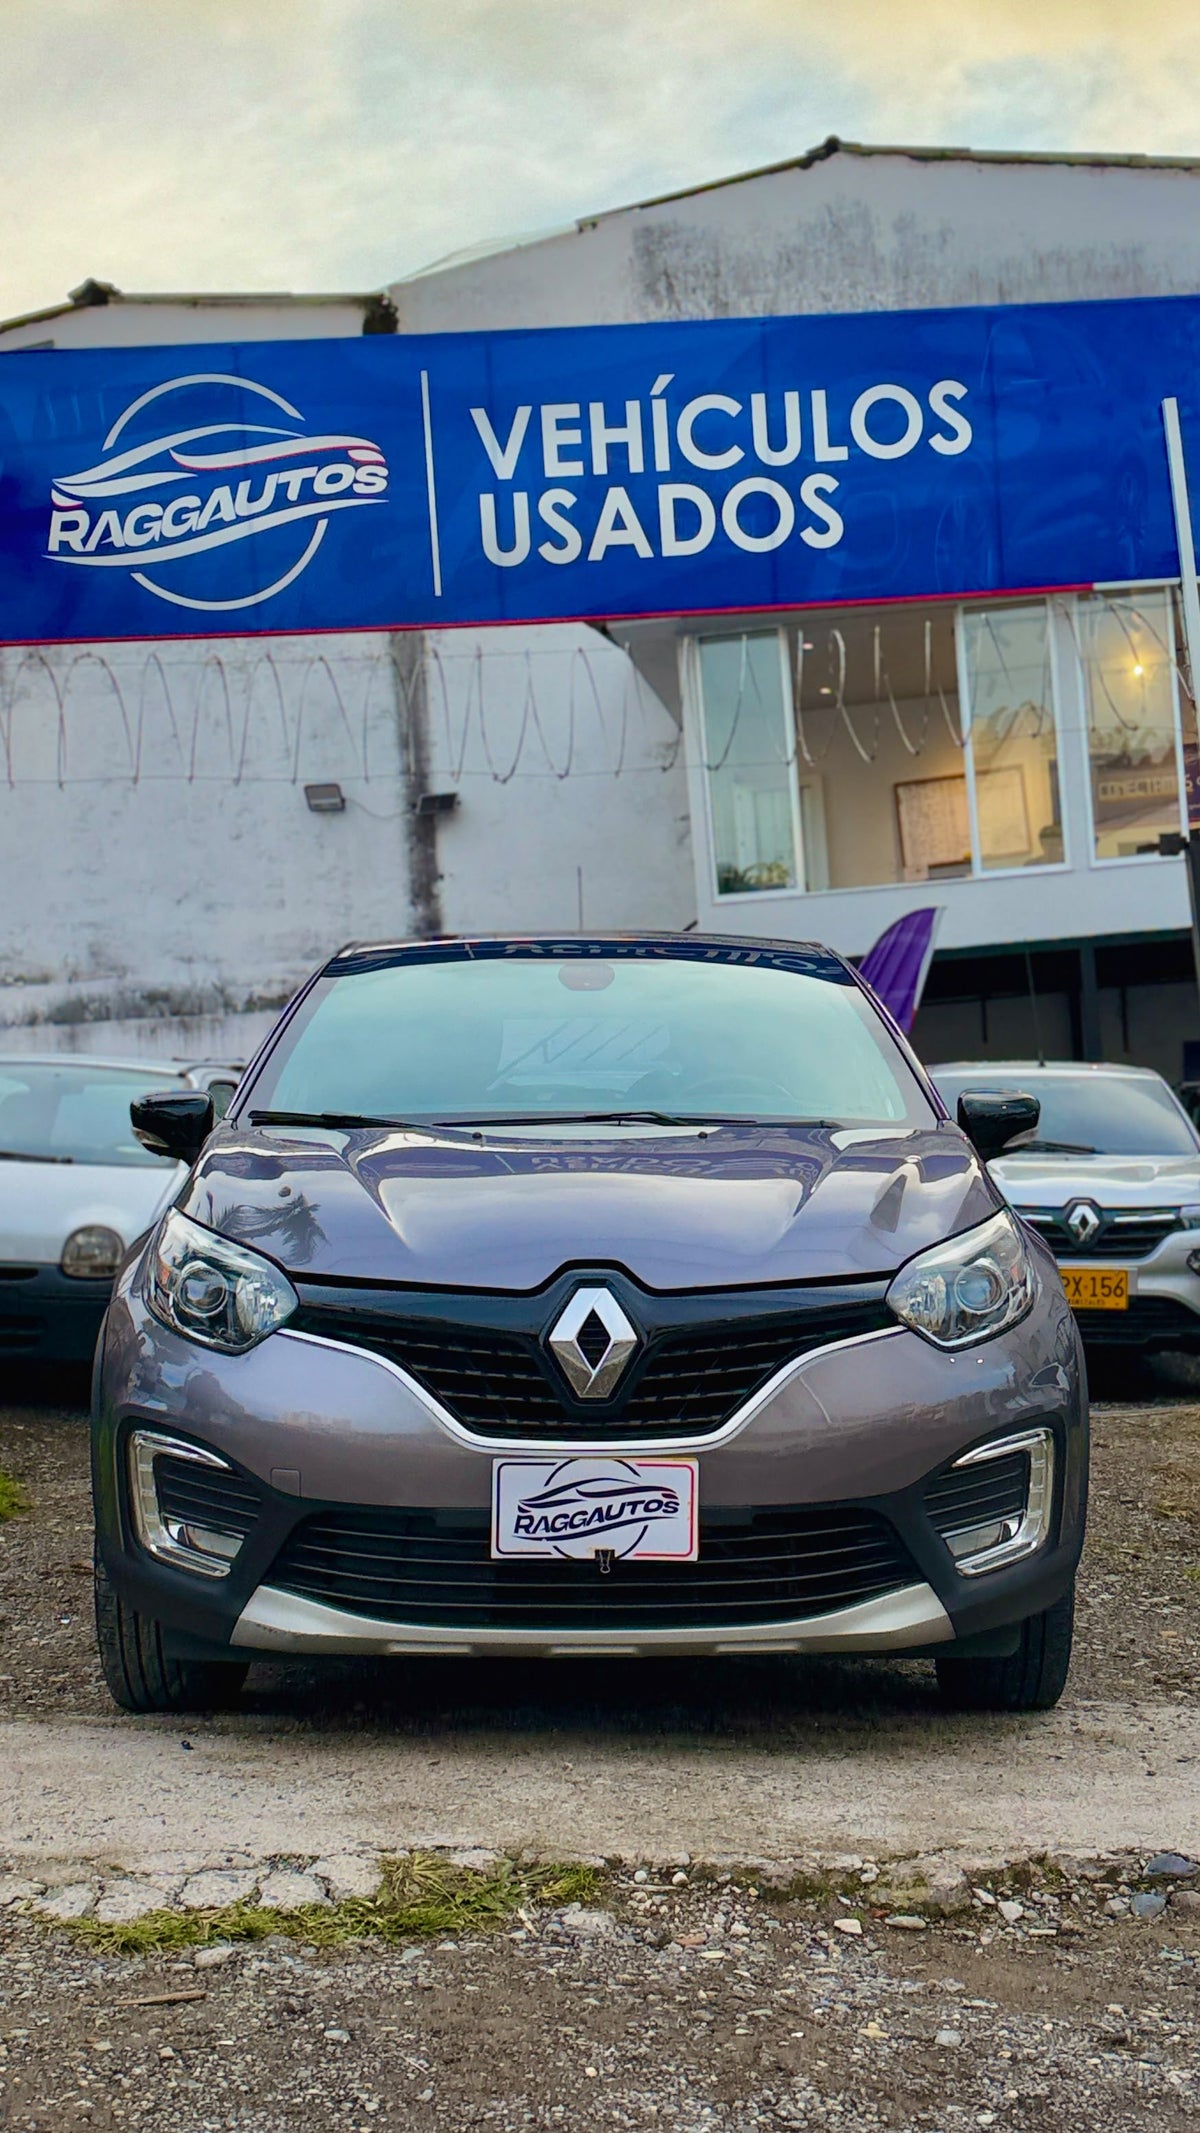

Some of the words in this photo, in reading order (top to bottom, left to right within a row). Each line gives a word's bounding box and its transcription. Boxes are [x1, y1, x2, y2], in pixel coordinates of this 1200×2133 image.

[469, 374, 973, 480] VEHÍCULOS
[48, 463, 389, 553] RAGGAUTOS
[479, 473, 844, 567] USADOS
[514, 1499, 680, 1535] RAGGAUTOS
